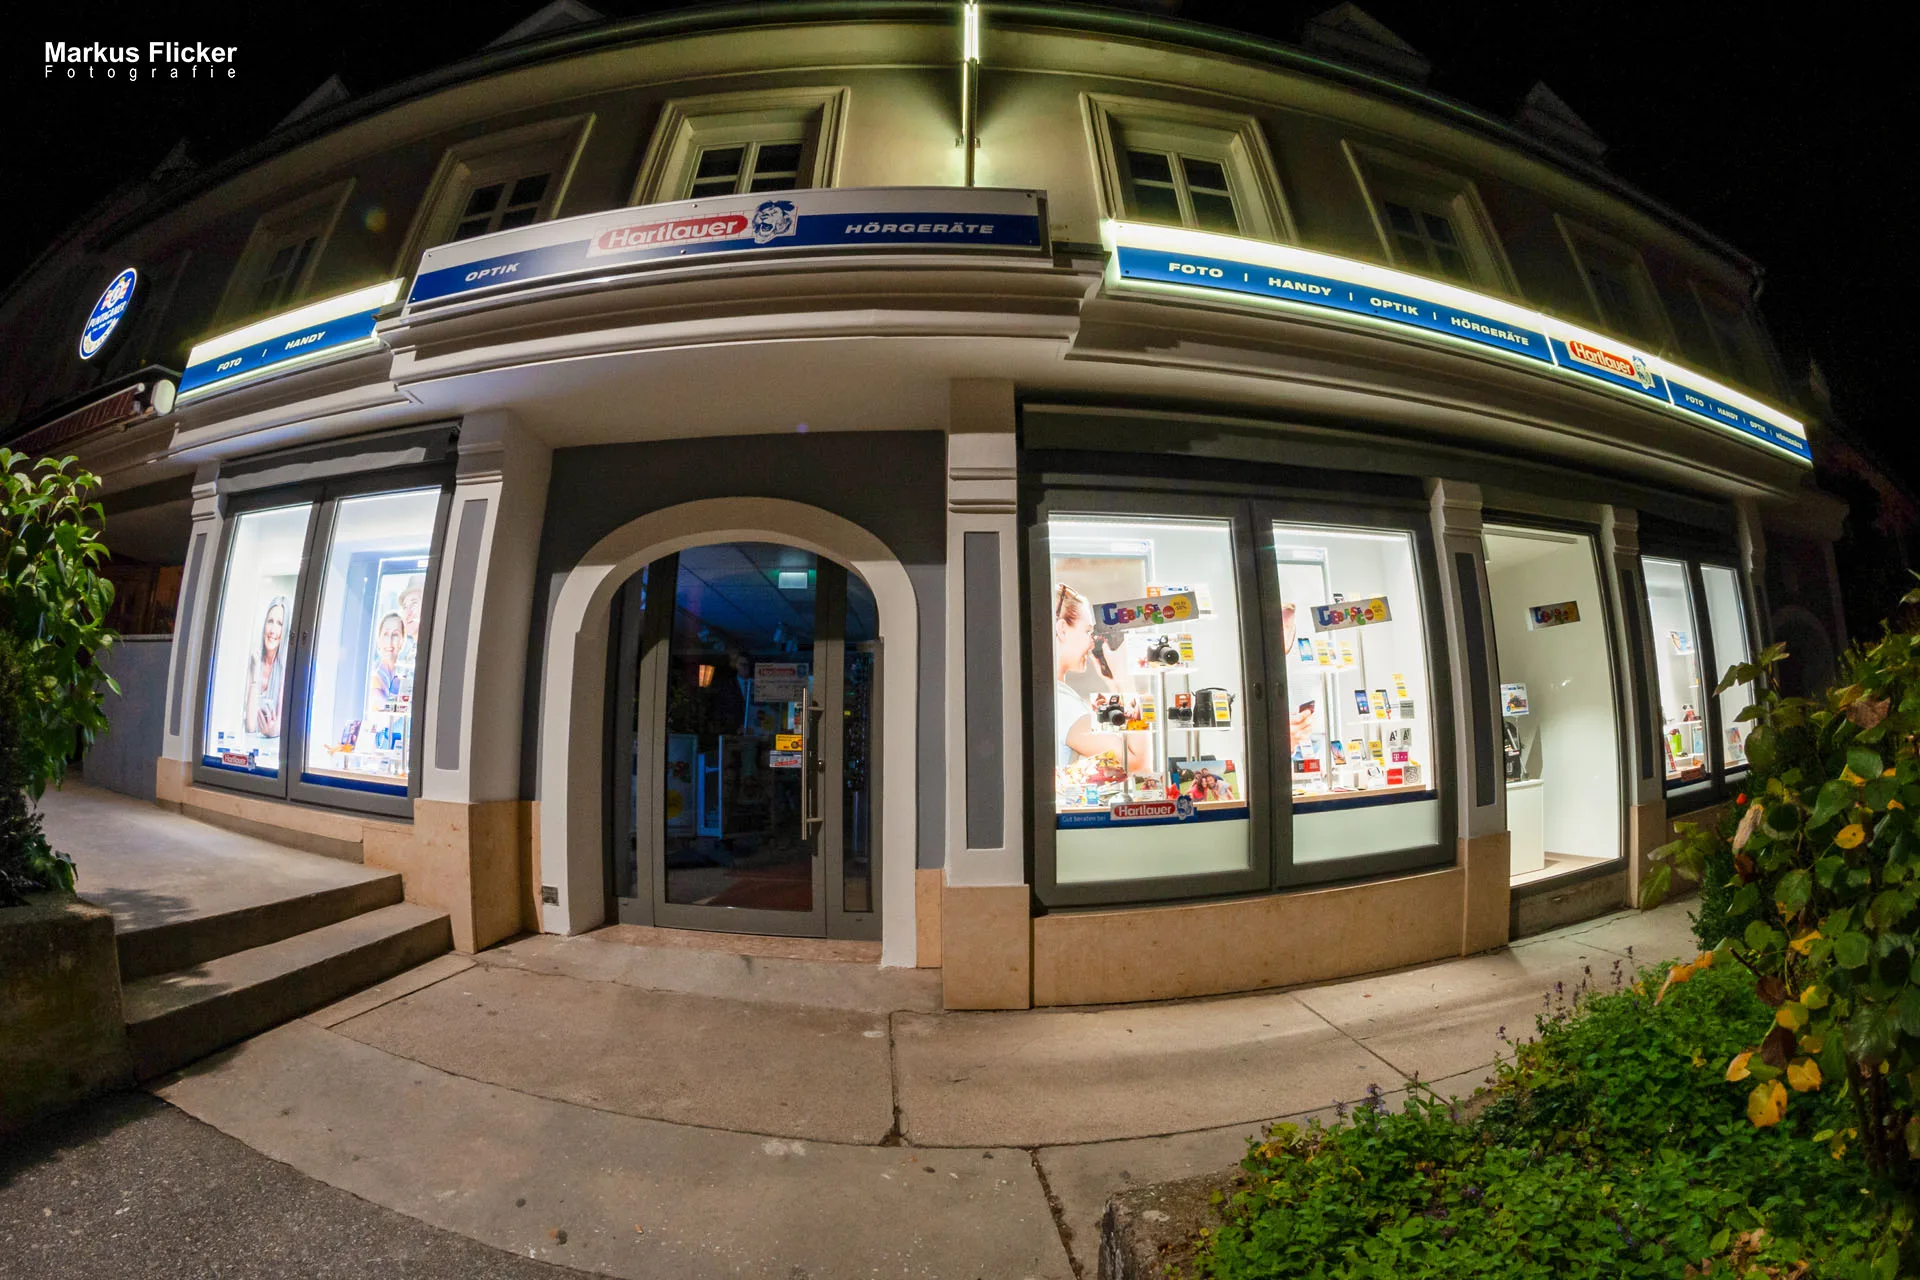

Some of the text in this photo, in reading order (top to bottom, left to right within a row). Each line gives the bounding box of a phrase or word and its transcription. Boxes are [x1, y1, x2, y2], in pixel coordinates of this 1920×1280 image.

[607, 219, 738, 248] Hartlauer
[845, 221, 995, 234] HÖRGERÄTE
[465, 262, 519, 282] OPTIK
[1168, 262, 1530, 346] FOTO HANDY OPTIK HÖRGERÄTE
[216, 331, 326, 372] FOTO HANDY
[1574, 342, 1632, 375] Hartlauer
[1685, 394, 1705, 407] FOTO
[1717, 407, 1739, 421] HANDY
[1117, 804, 1173, 817] Hartlauer
